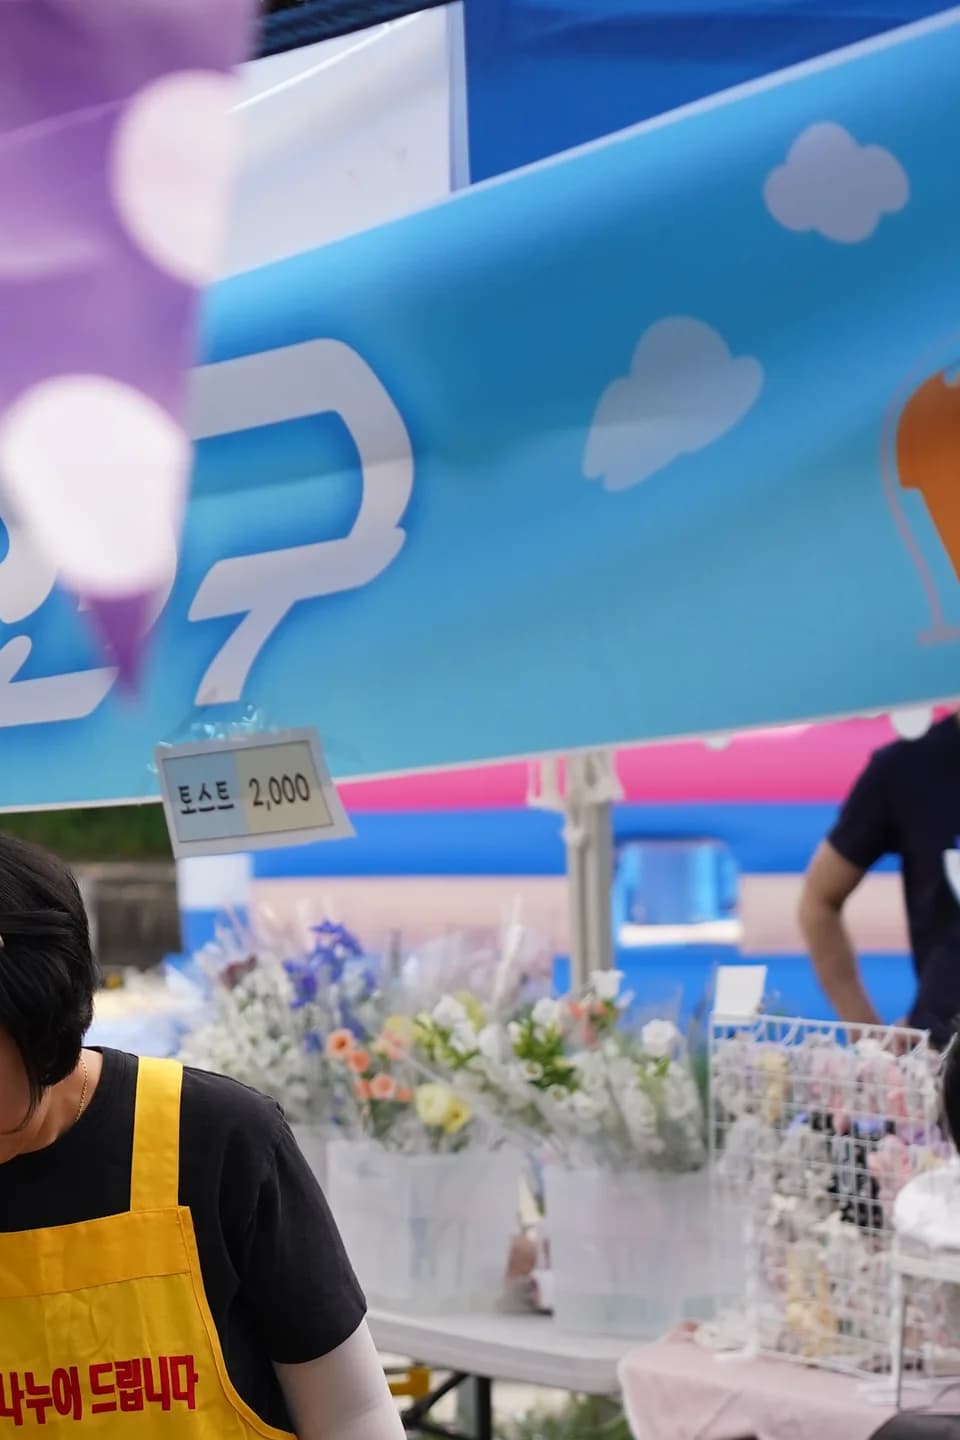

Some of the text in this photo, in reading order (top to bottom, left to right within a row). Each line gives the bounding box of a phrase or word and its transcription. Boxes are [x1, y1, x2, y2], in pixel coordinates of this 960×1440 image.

[178, 772, 311, 815] 토스트 2,000
[88, 1355, 199, 1415] 드립니다
